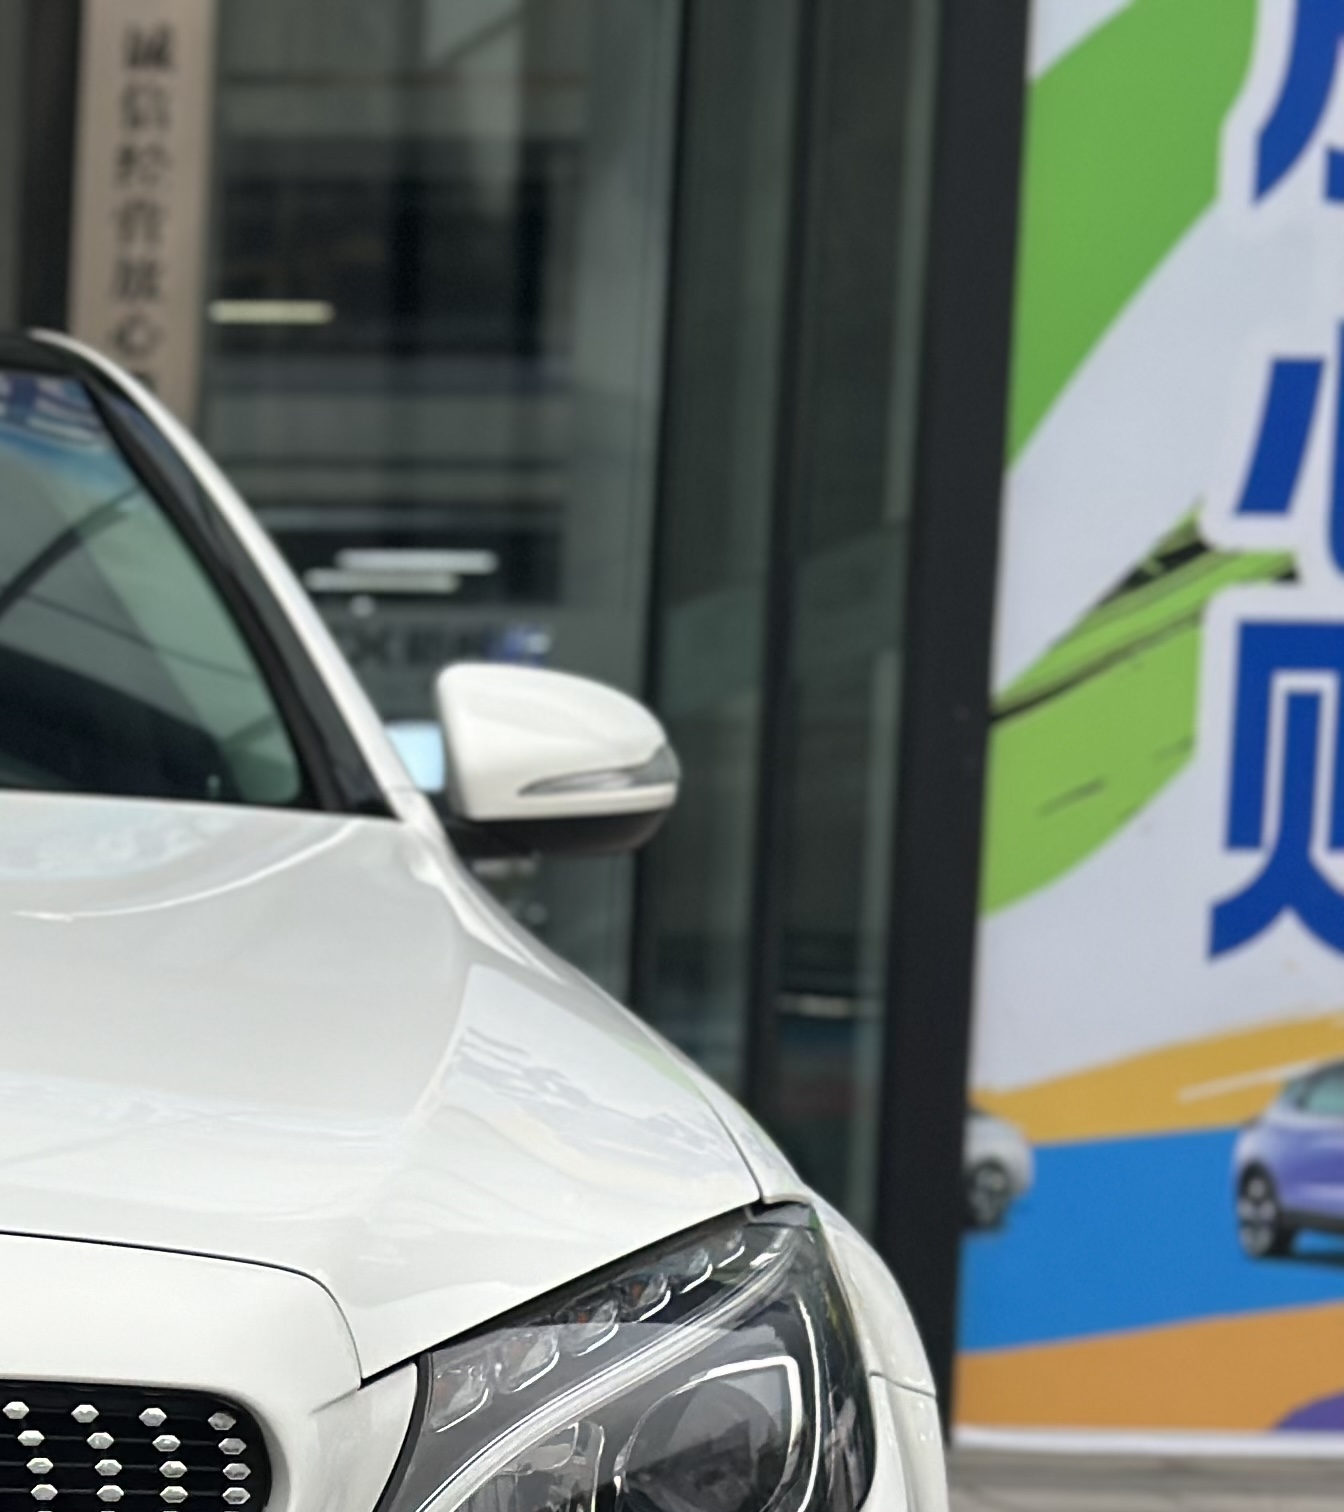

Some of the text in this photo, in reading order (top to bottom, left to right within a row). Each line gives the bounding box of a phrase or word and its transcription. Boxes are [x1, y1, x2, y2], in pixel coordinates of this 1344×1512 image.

[108, 20, 175, 392] 诚信经营放心
